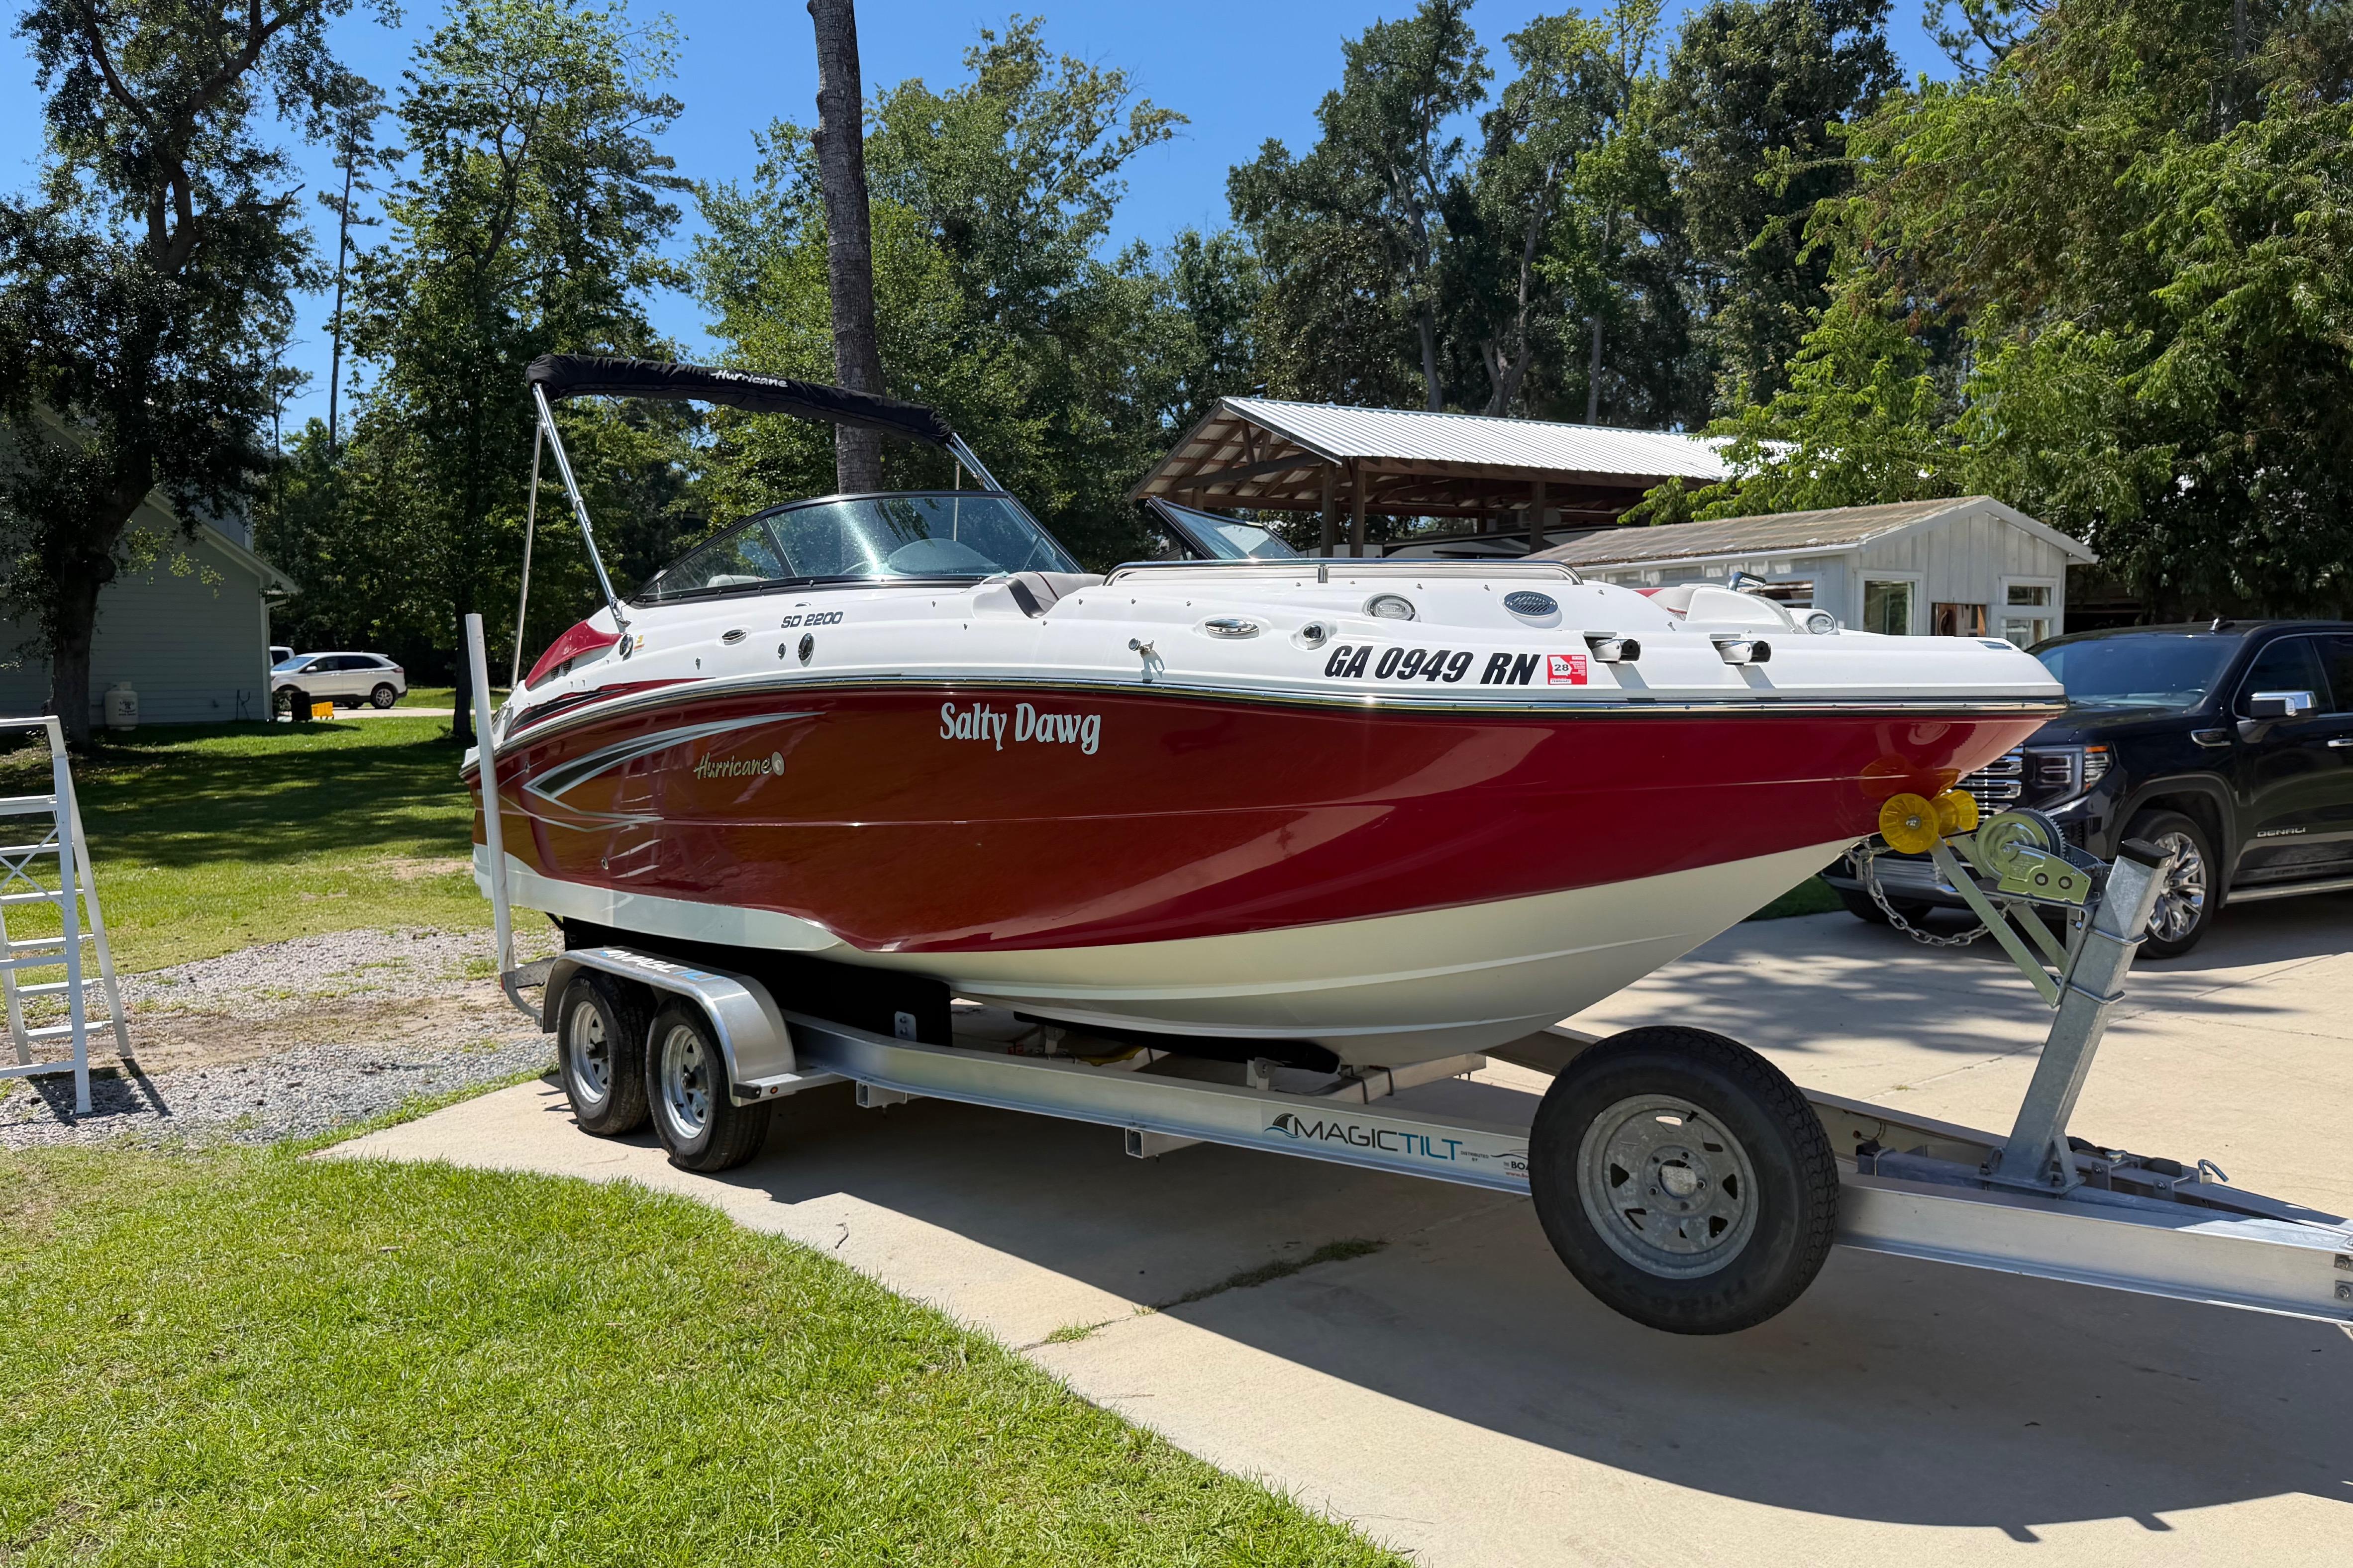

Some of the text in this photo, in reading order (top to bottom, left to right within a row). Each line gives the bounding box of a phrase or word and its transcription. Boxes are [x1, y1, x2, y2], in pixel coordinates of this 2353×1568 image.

[711, 370, 788, 388] Hurricane
[781, 611, 844, 628] SD 2200
[1324, 646, 1541, 685] GA 0949 RN
[940, 702, 1101, 755] Salty Dawg
[693, 752, 772, 780] Hurricane
[2257, 827, 2306, 837] DENALI
[1294, 1116, 1463, 1160] MAGICTILT
